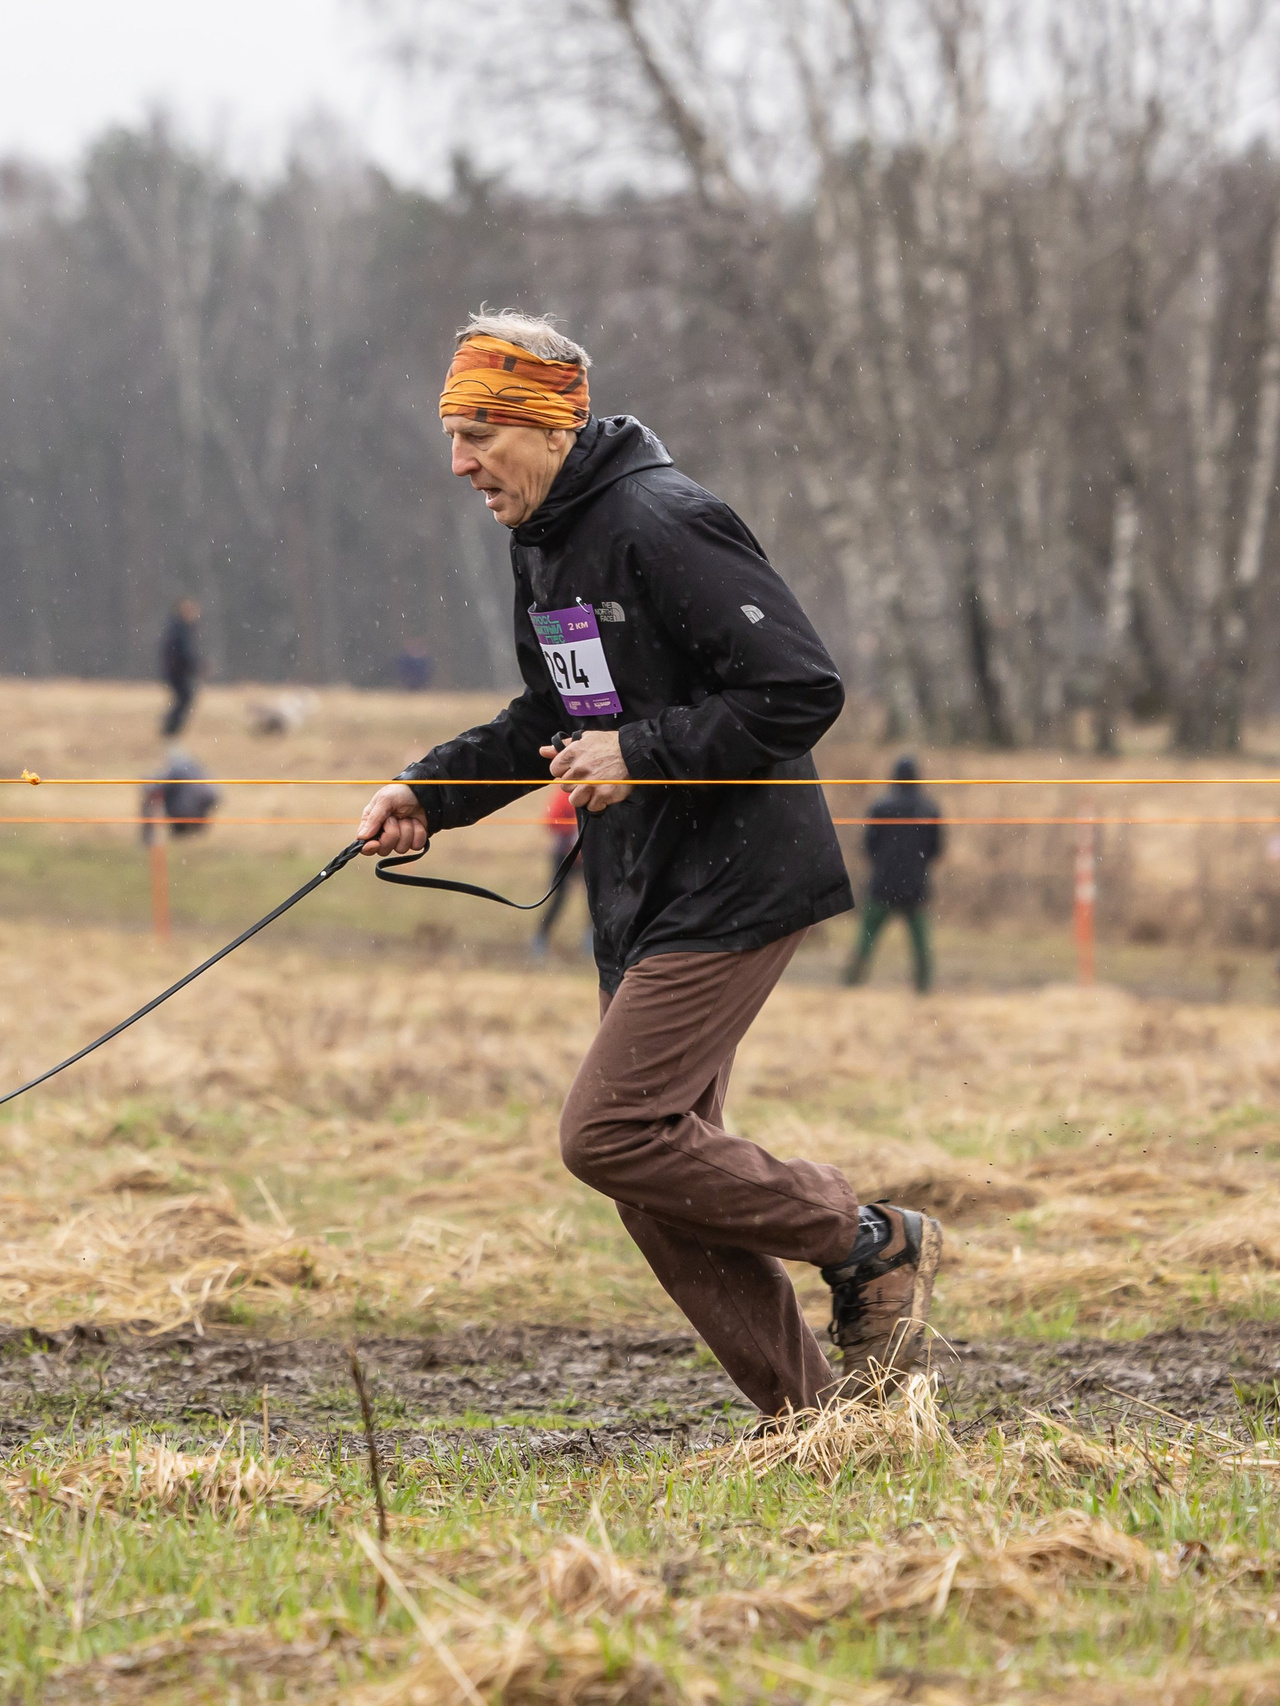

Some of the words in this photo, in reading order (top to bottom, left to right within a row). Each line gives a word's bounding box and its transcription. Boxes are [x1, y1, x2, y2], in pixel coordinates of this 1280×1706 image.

[601, 601, 612, 609] THE
[594, 608, 613, 616] NORTH
[567, 622, 575, 631] 2
